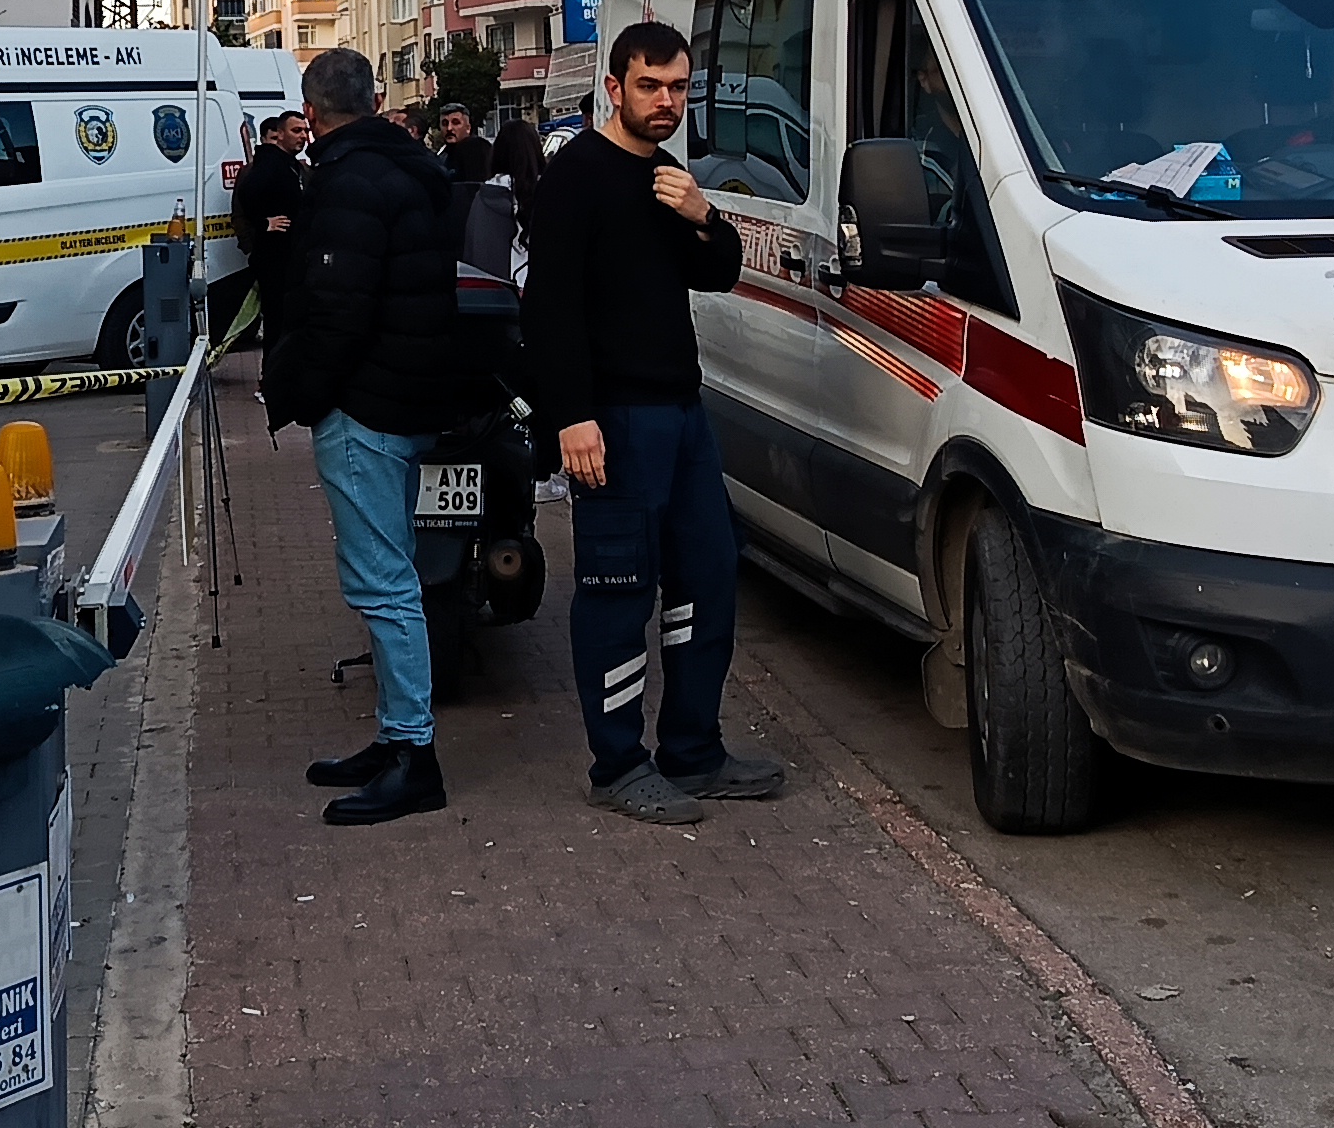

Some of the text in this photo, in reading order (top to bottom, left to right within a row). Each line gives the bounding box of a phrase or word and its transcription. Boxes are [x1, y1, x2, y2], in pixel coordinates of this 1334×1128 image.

[1228, 178, 1240, 189] M
[439, 467, 478, 488] AYR
[437, 491, 478, 511] 509
[12, 1038, 37, 1067] 84
